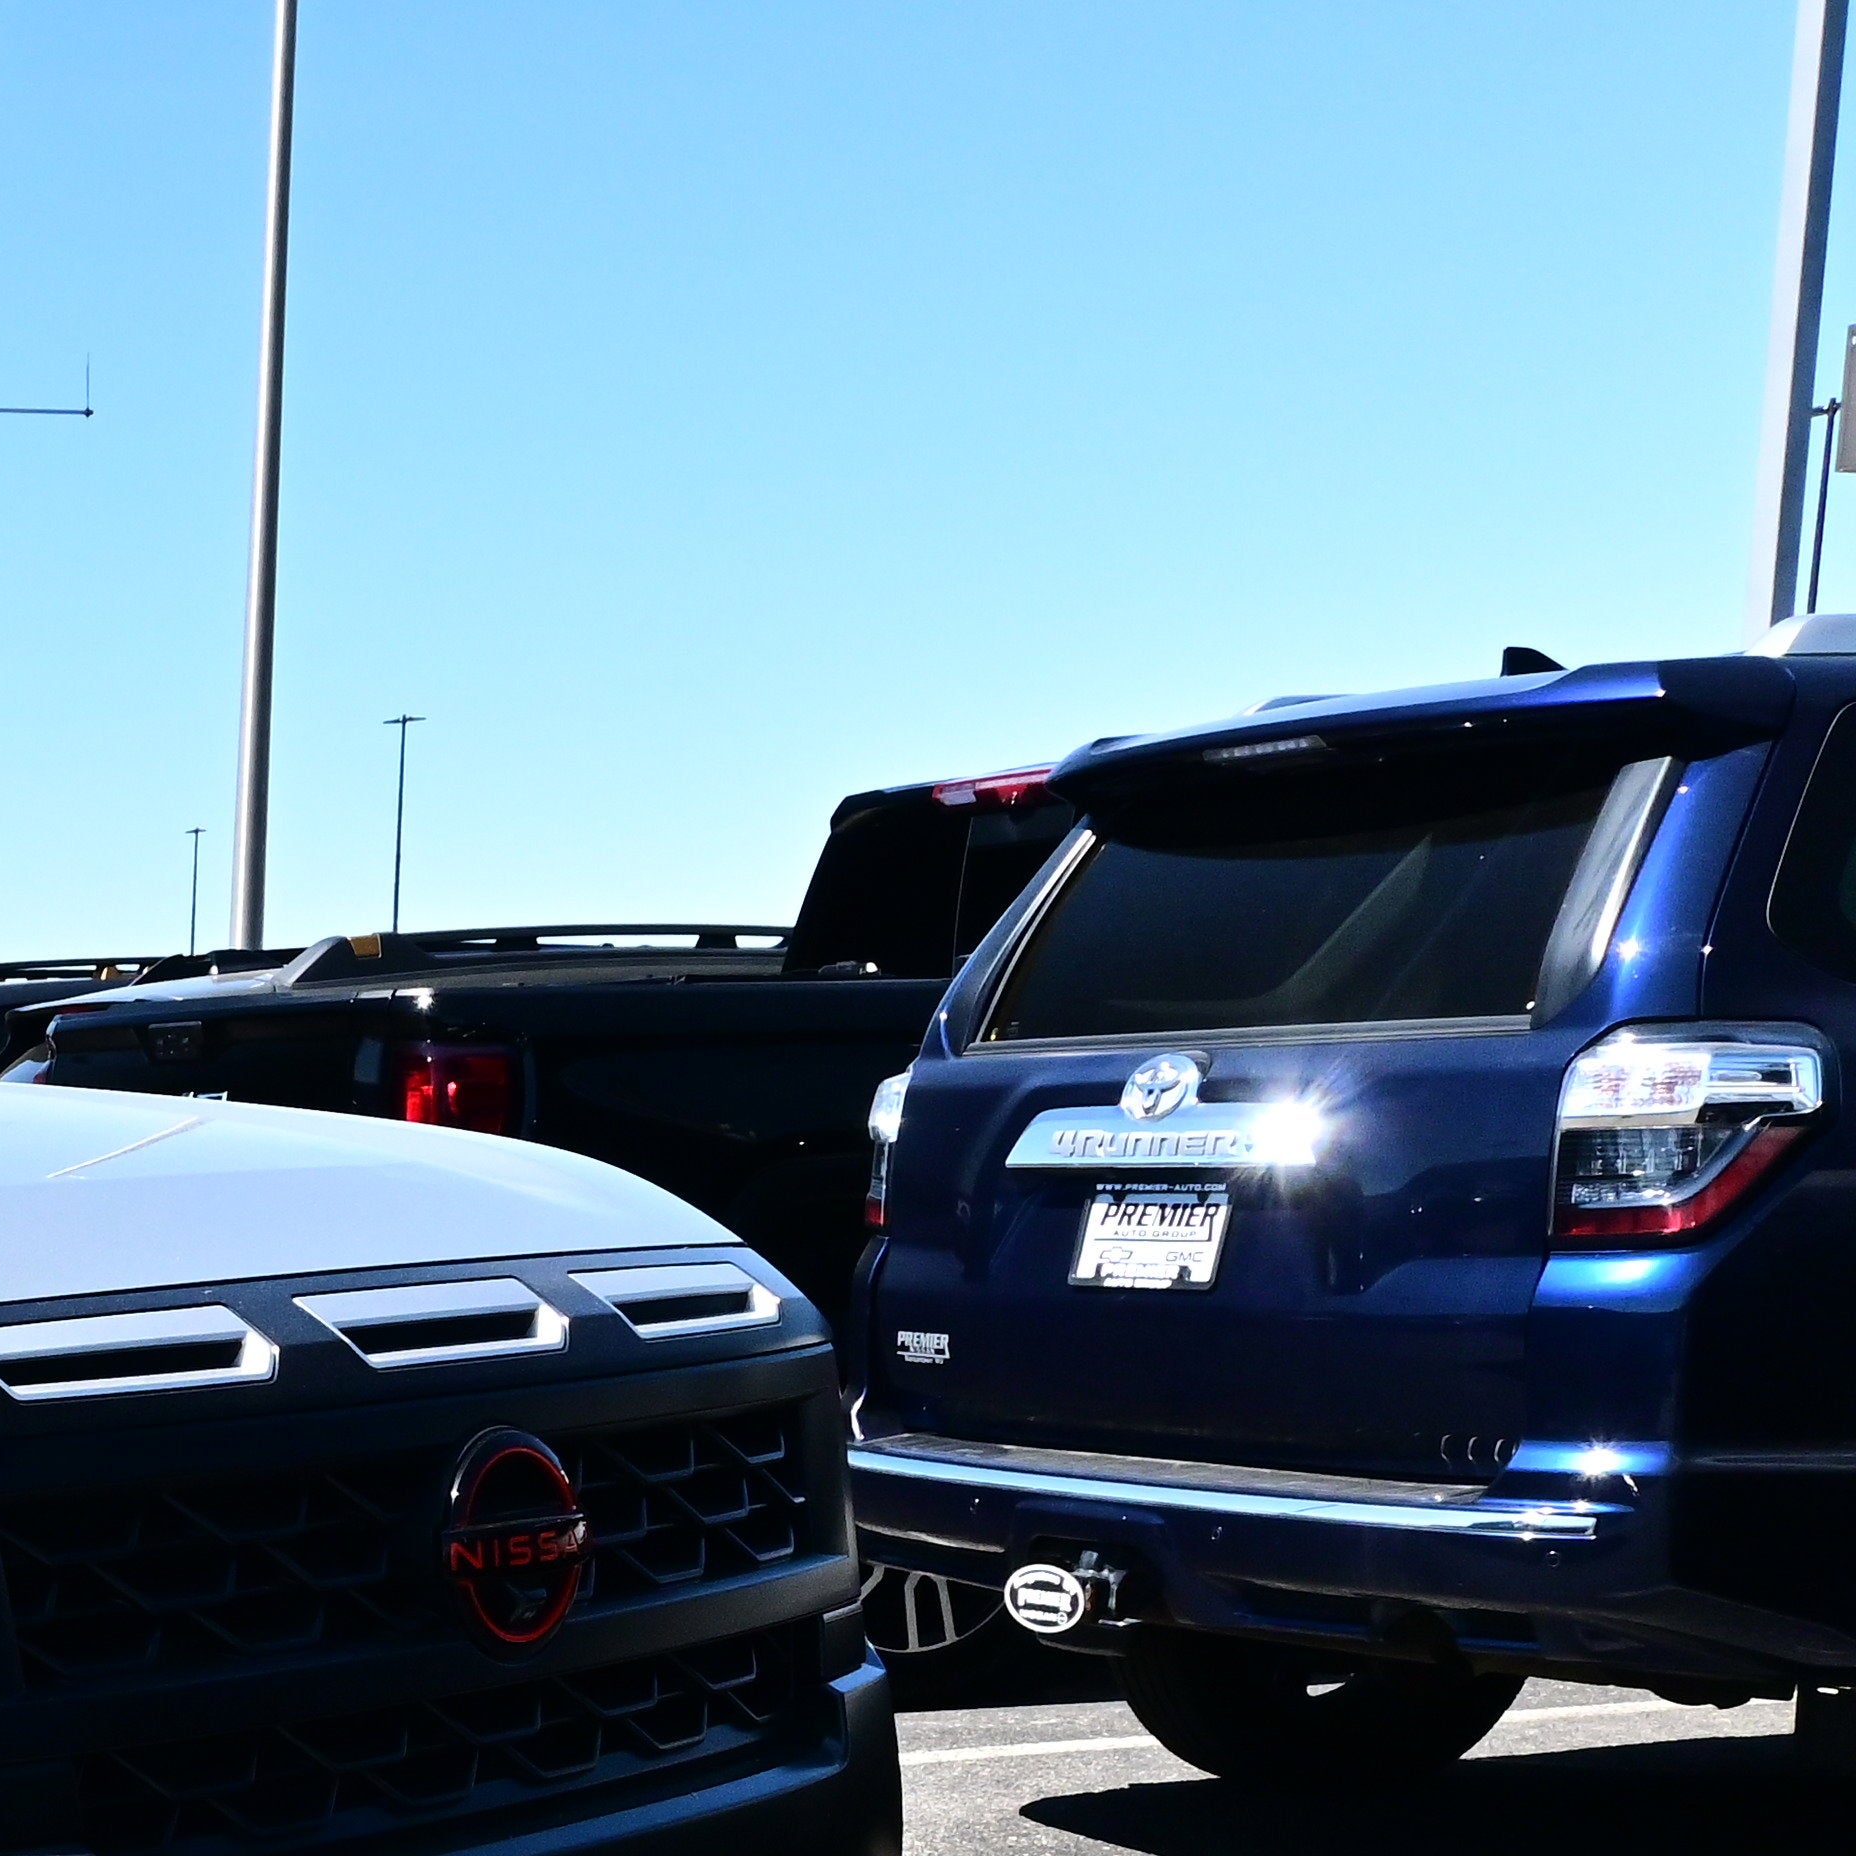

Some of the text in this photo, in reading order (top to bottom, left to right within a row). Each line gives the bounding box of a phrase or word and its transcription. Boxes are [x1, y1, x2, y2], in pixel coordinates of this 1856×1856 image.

[1100, 1202, 1222, 1228] PREMIER
[1113, 1230, 1197, 1238] AUTO GROUP
[1165, 1251, 1204, 1263] GMC
[897, 1331, 949, 1349] PREMIER
